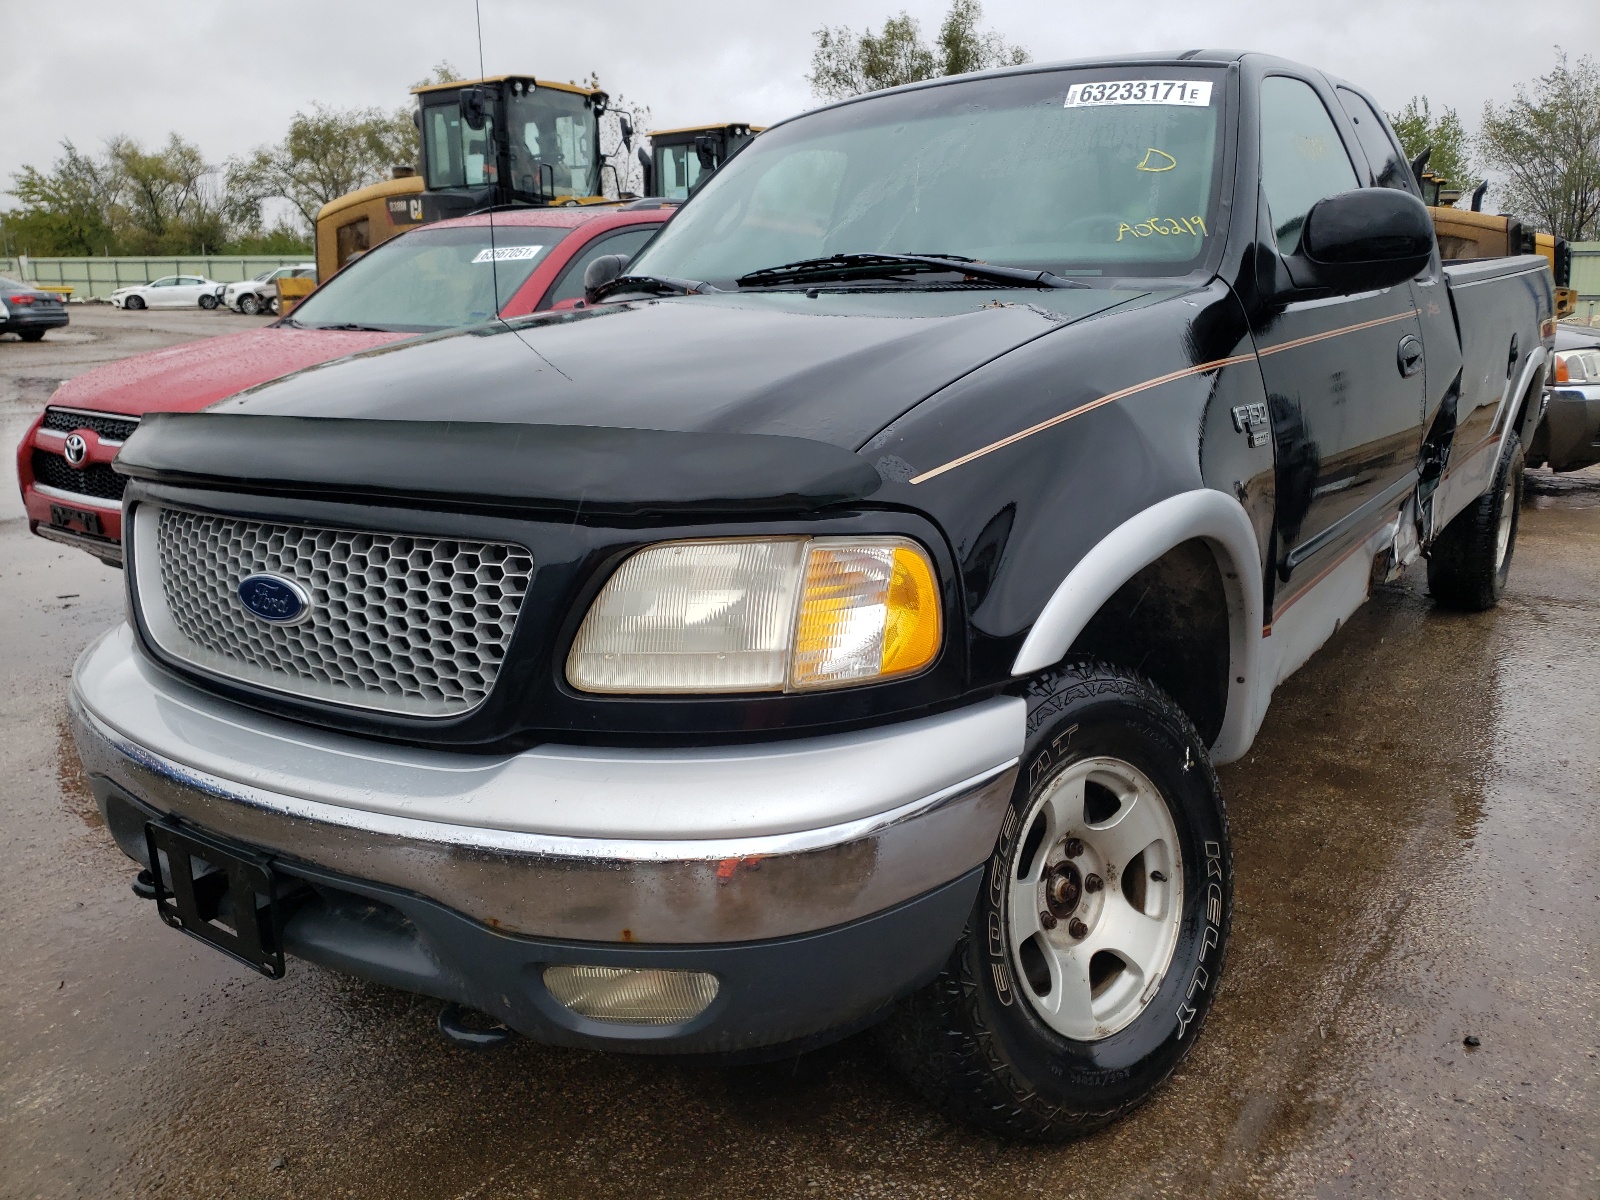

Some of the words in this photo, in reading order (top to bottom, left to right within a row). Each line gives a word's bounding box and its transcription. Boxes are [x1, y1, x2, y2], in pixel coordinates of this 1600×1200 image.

[1137, 148, 1177, 172] D
[988, 803, 1018, 1007] EDGE
[1029, 723, 1079, 794] AT
[1175, 840, 1222, 1040] KELLY
